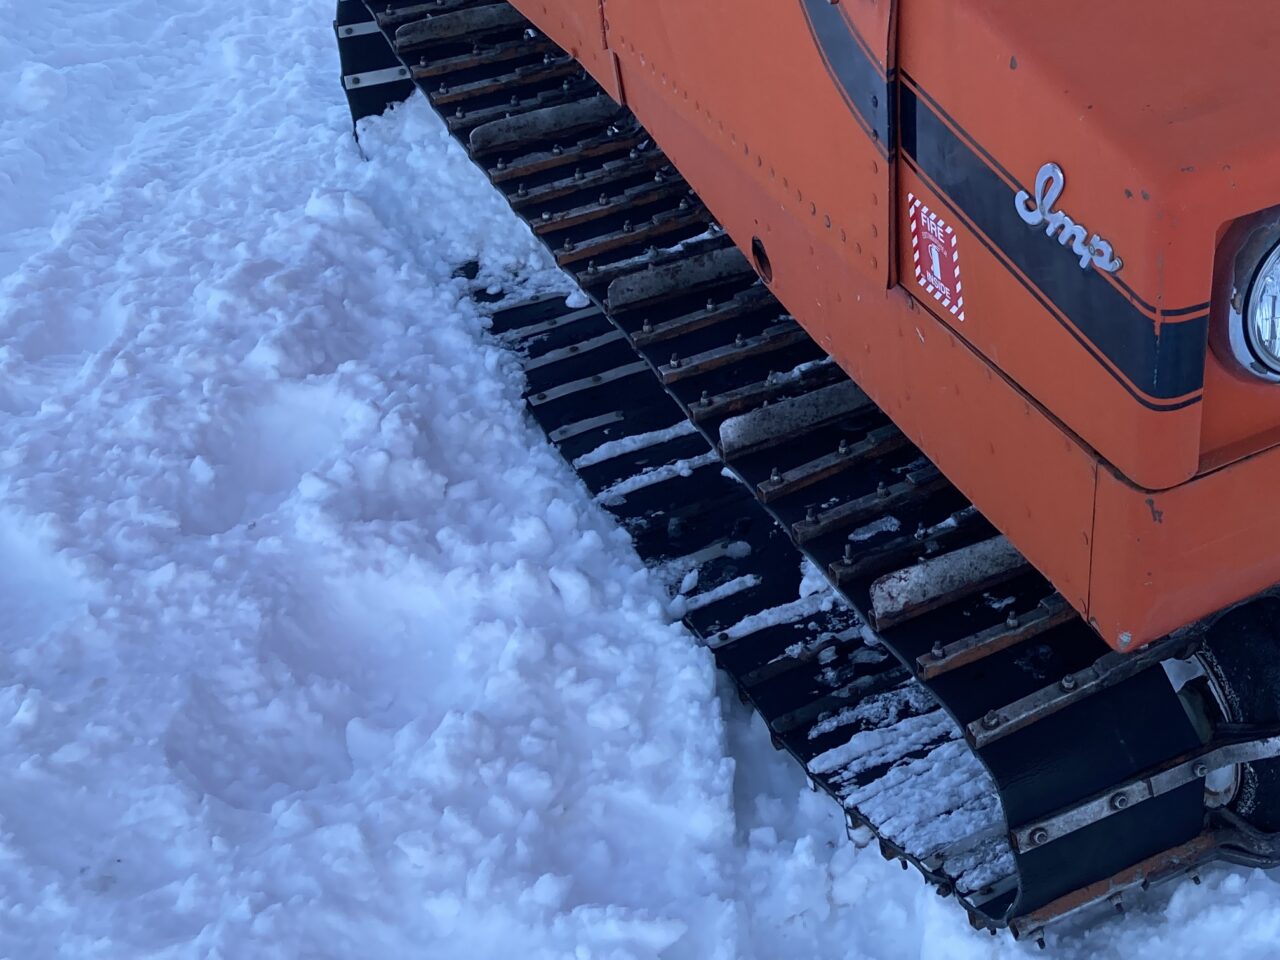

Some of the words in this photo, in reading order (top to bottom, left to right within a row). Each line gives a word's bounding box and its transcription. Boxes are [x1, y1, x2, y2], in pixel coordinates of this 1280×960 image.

[920, 212, 945, 244] FIRE
[1014, 161, 1124, 273] Imp
[926, 270, 951, 300] INSIDE
